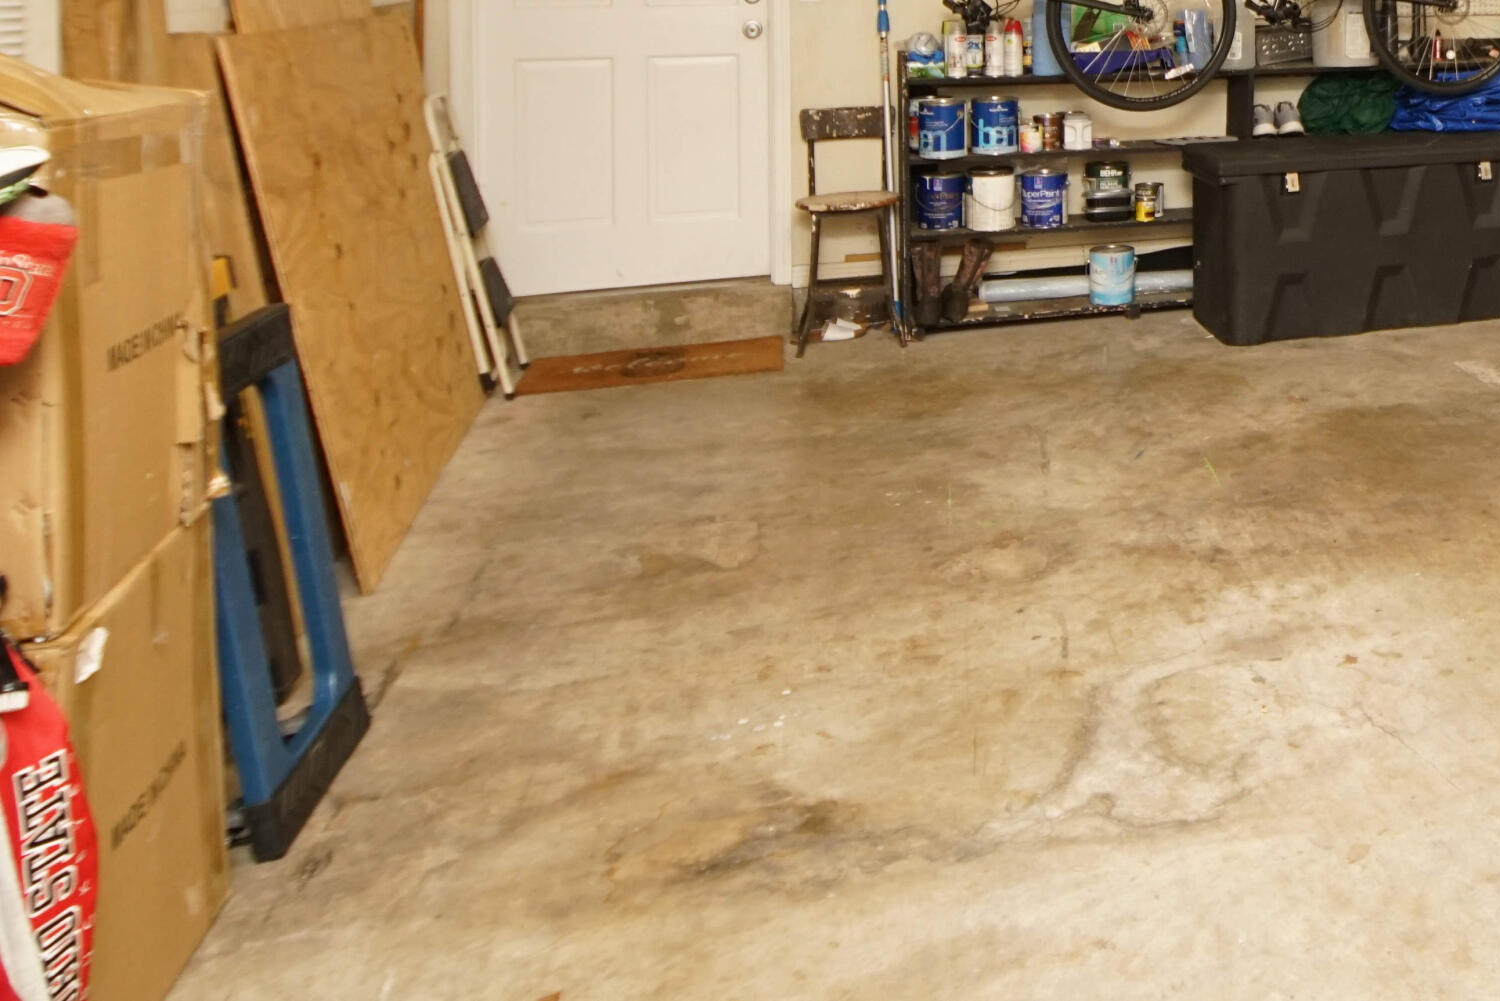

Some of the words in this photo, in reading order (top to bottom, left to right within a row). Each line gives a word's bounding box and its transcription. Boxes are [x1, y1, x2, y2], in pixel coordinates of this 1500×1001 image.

[106, 332, 140, 372] MADE
[12, 748, 77, 918] STATE
[34, 904, 83, 1000] HIO
